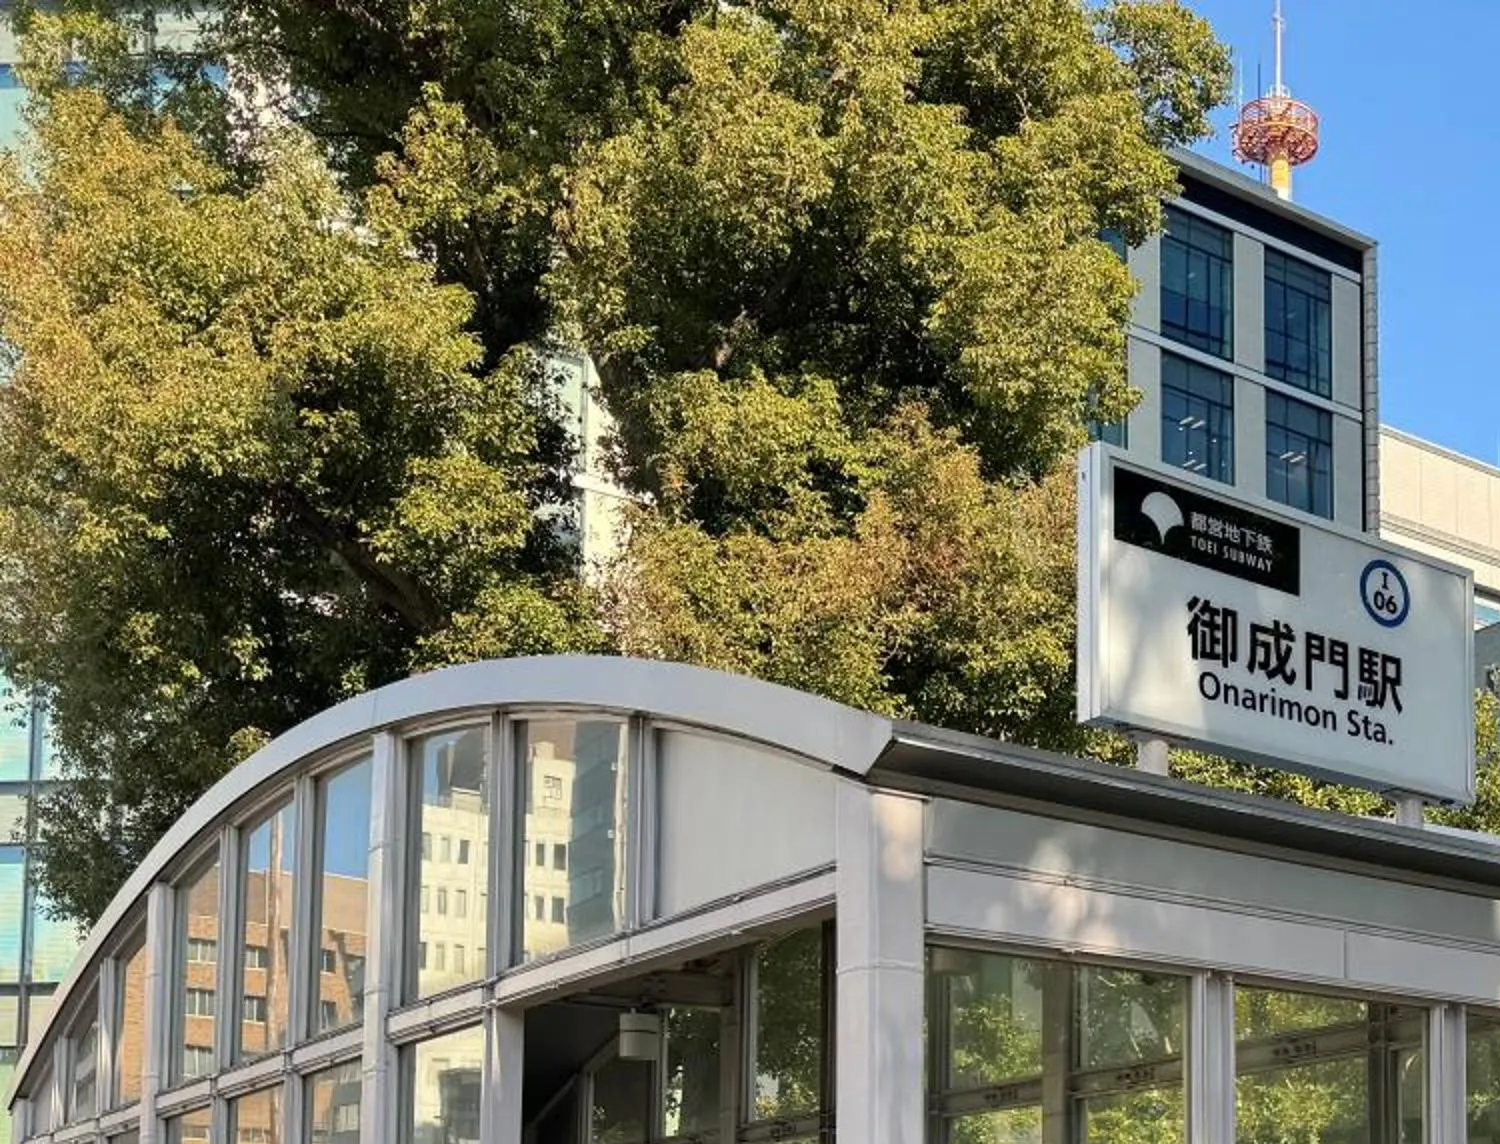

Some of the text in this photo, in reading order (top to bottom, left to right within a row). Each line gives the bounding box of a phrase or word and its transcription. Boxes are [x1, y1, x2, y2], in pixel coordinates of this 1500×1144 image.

[1190, 511, 1274, 555] 都営地下鉄
[1190, 535, 1274, 573] TOEI SUBWAY
[1373, 591, 1398, 616] 06
[1186, 596, 1404, 715] 御成門駅
[1199, 671, 1395, 746] Onarimon Sta.
